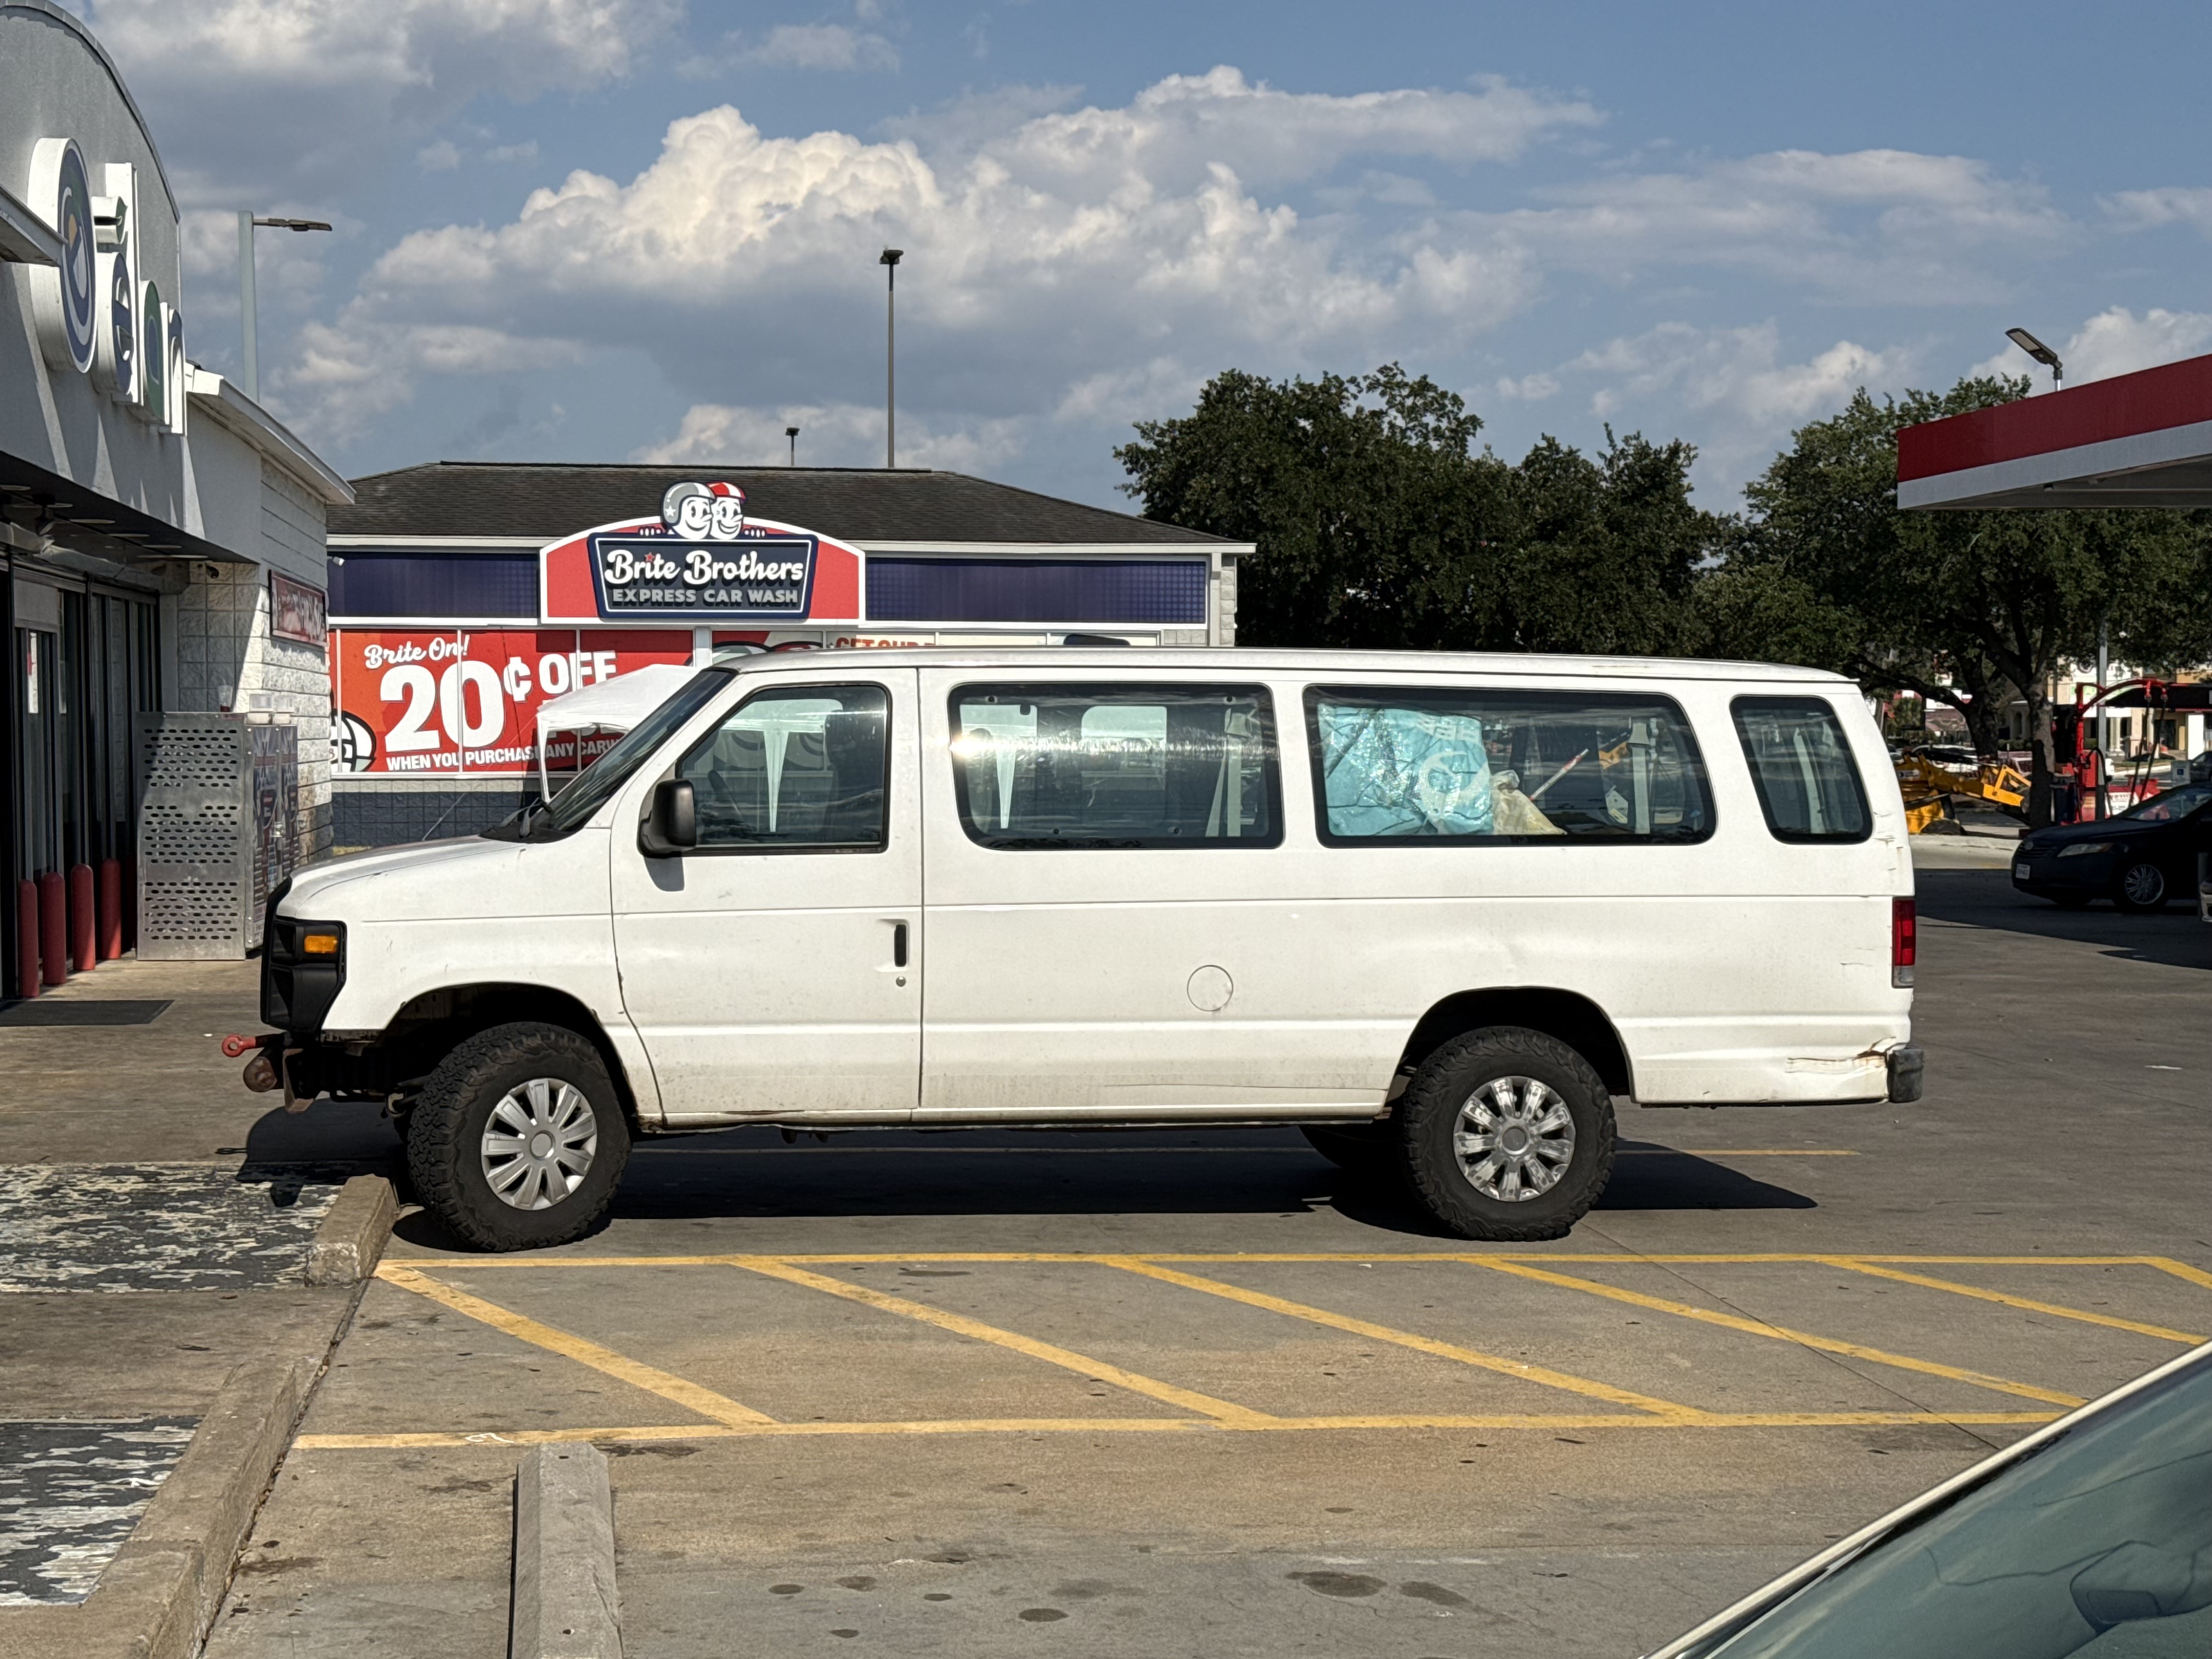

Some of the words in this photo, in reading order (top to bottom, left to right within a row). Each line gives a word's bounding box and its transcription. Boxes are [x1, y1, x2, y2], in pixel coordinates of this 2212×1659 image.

[605, 549, 681, 585] Brite
[683, 550, 803, 585] Brothers
[613, 589, 697, 602] EXPRESS
[704, 589, 742, 602] CAR
[748, 589, 798, 602] WASH
[364, 640, 427, 669] Brite
[428, 634, 470, 661] On!
[538, 650, 616, 695] OFF
[386, 753, 431, 771] WHEN
[431, 751, 460, 768] YOU
[465, 746, 539, 766] PURCHAS
[545, 743, 575, 759] ANY
